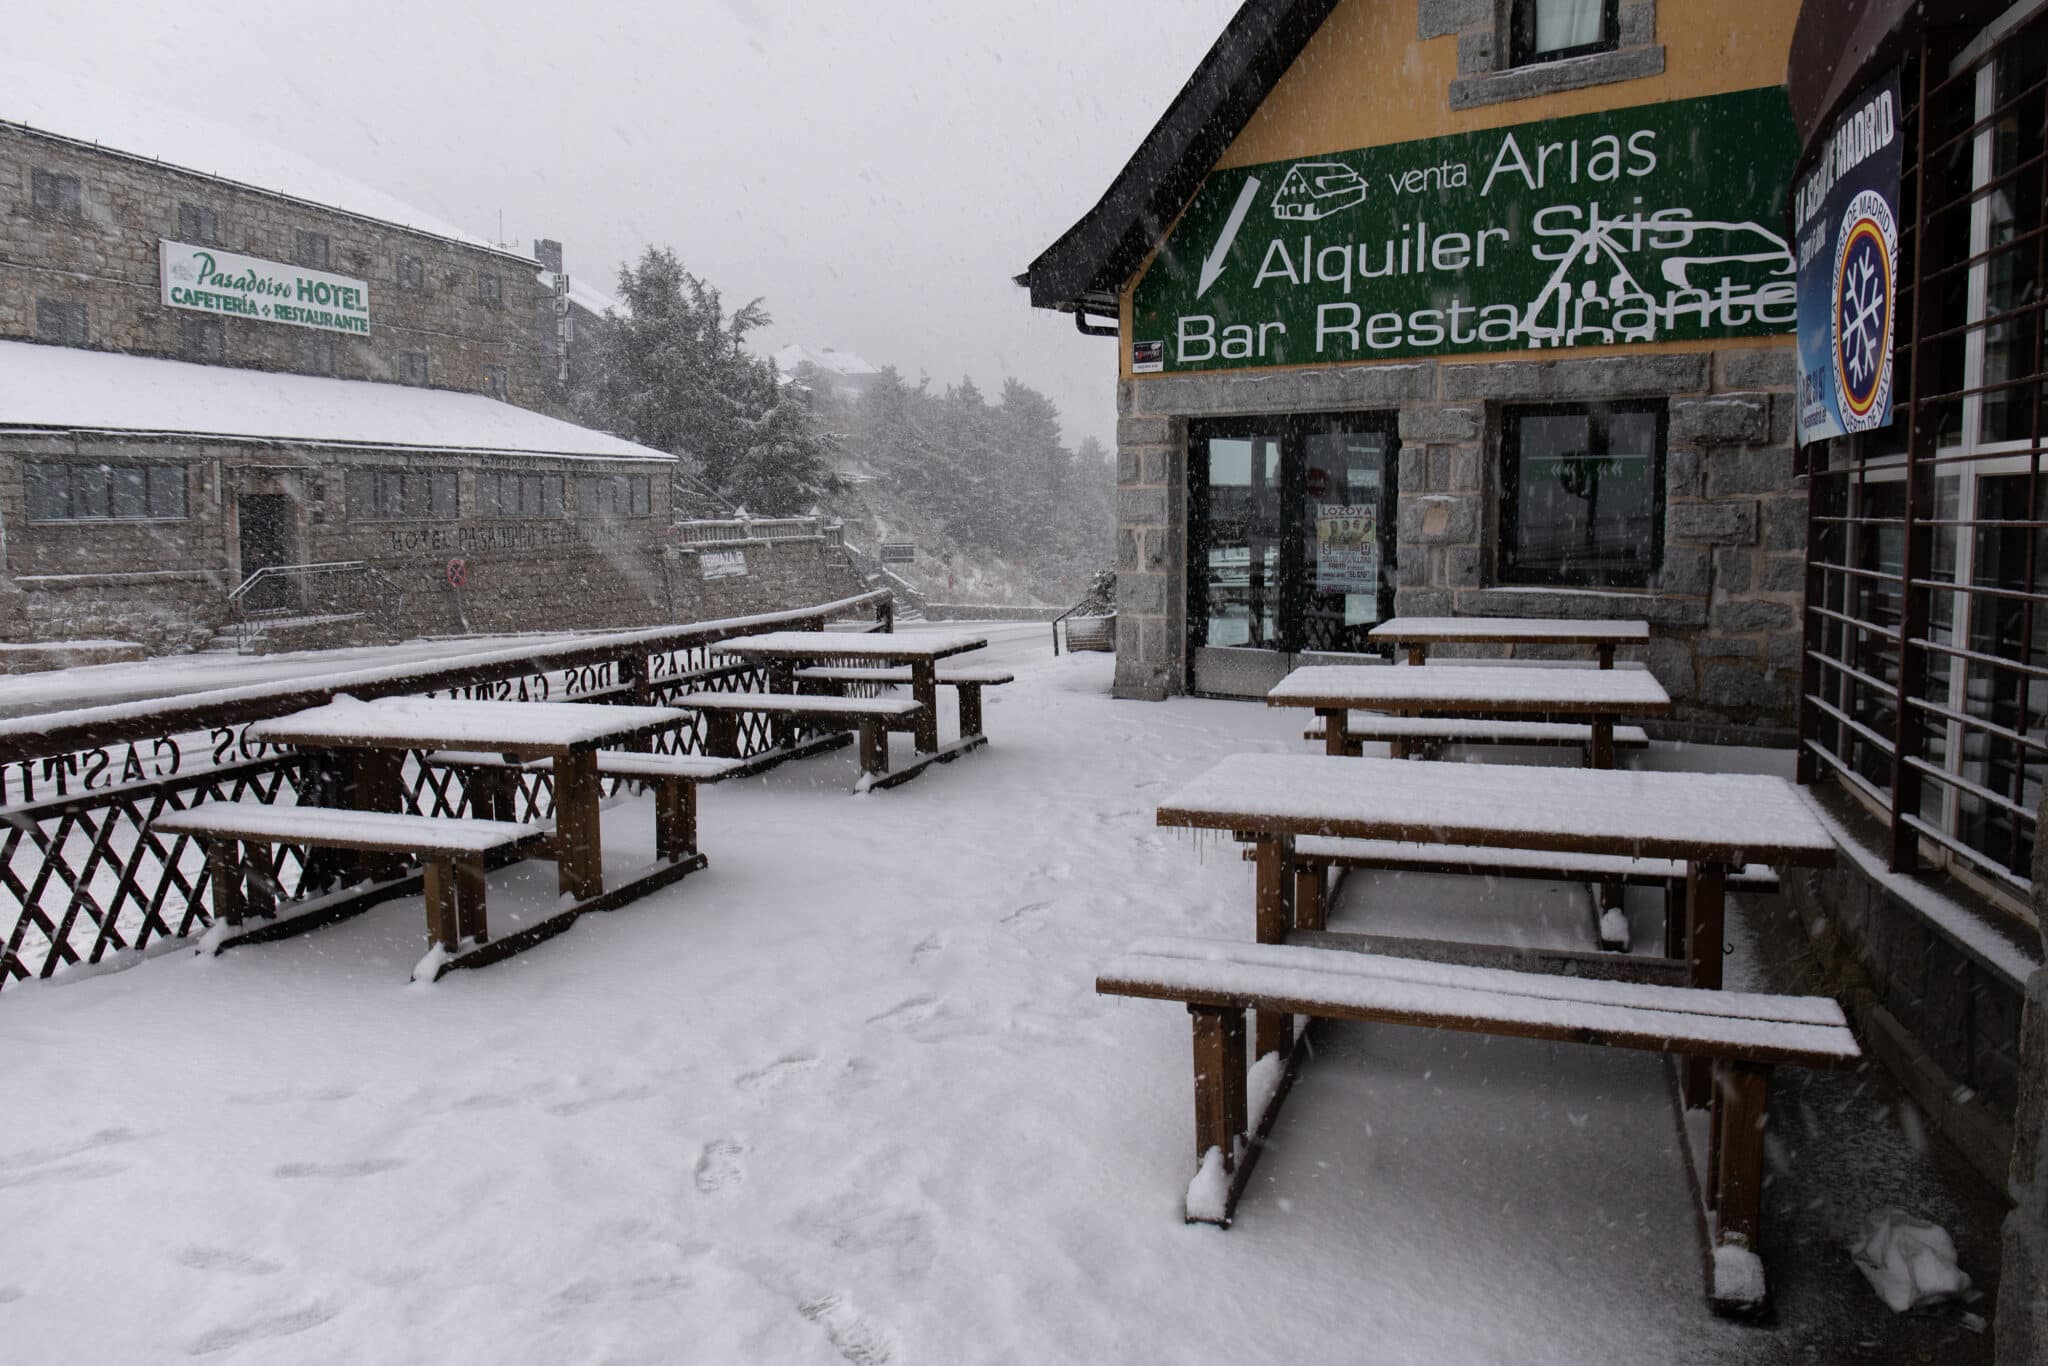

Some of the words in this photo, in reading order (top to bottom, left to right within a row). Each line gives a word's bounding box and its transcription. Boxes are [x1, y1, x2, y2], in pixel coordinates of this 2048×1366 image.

[1388, 159, 1468, 196] venta
[1479, 129, 1657, 197] Arias
[1836, 89, 1895, 182] MADRID
[1253, 222, 1510, 294] Alquiler
[1531, 196, 1695, 264] Skis
[1847, 204, 1858, 226] DE
[1859, 196, 1890, 233] MADRID
[170, 286, 259, 317] CAFETERÍA
[273, 302, 369, 333] RESTAURANTE
[192, 251, 292, 299] Pasadoiro
[296, 277, 368, 313] HOTEL
[1178, 315, 1286, 363] Bar
[1315, 276, 1798, 355] Restaurante
[1867, 409, 1878, 428] DE
[1322, 506, 1371, 516] LOZOYA
